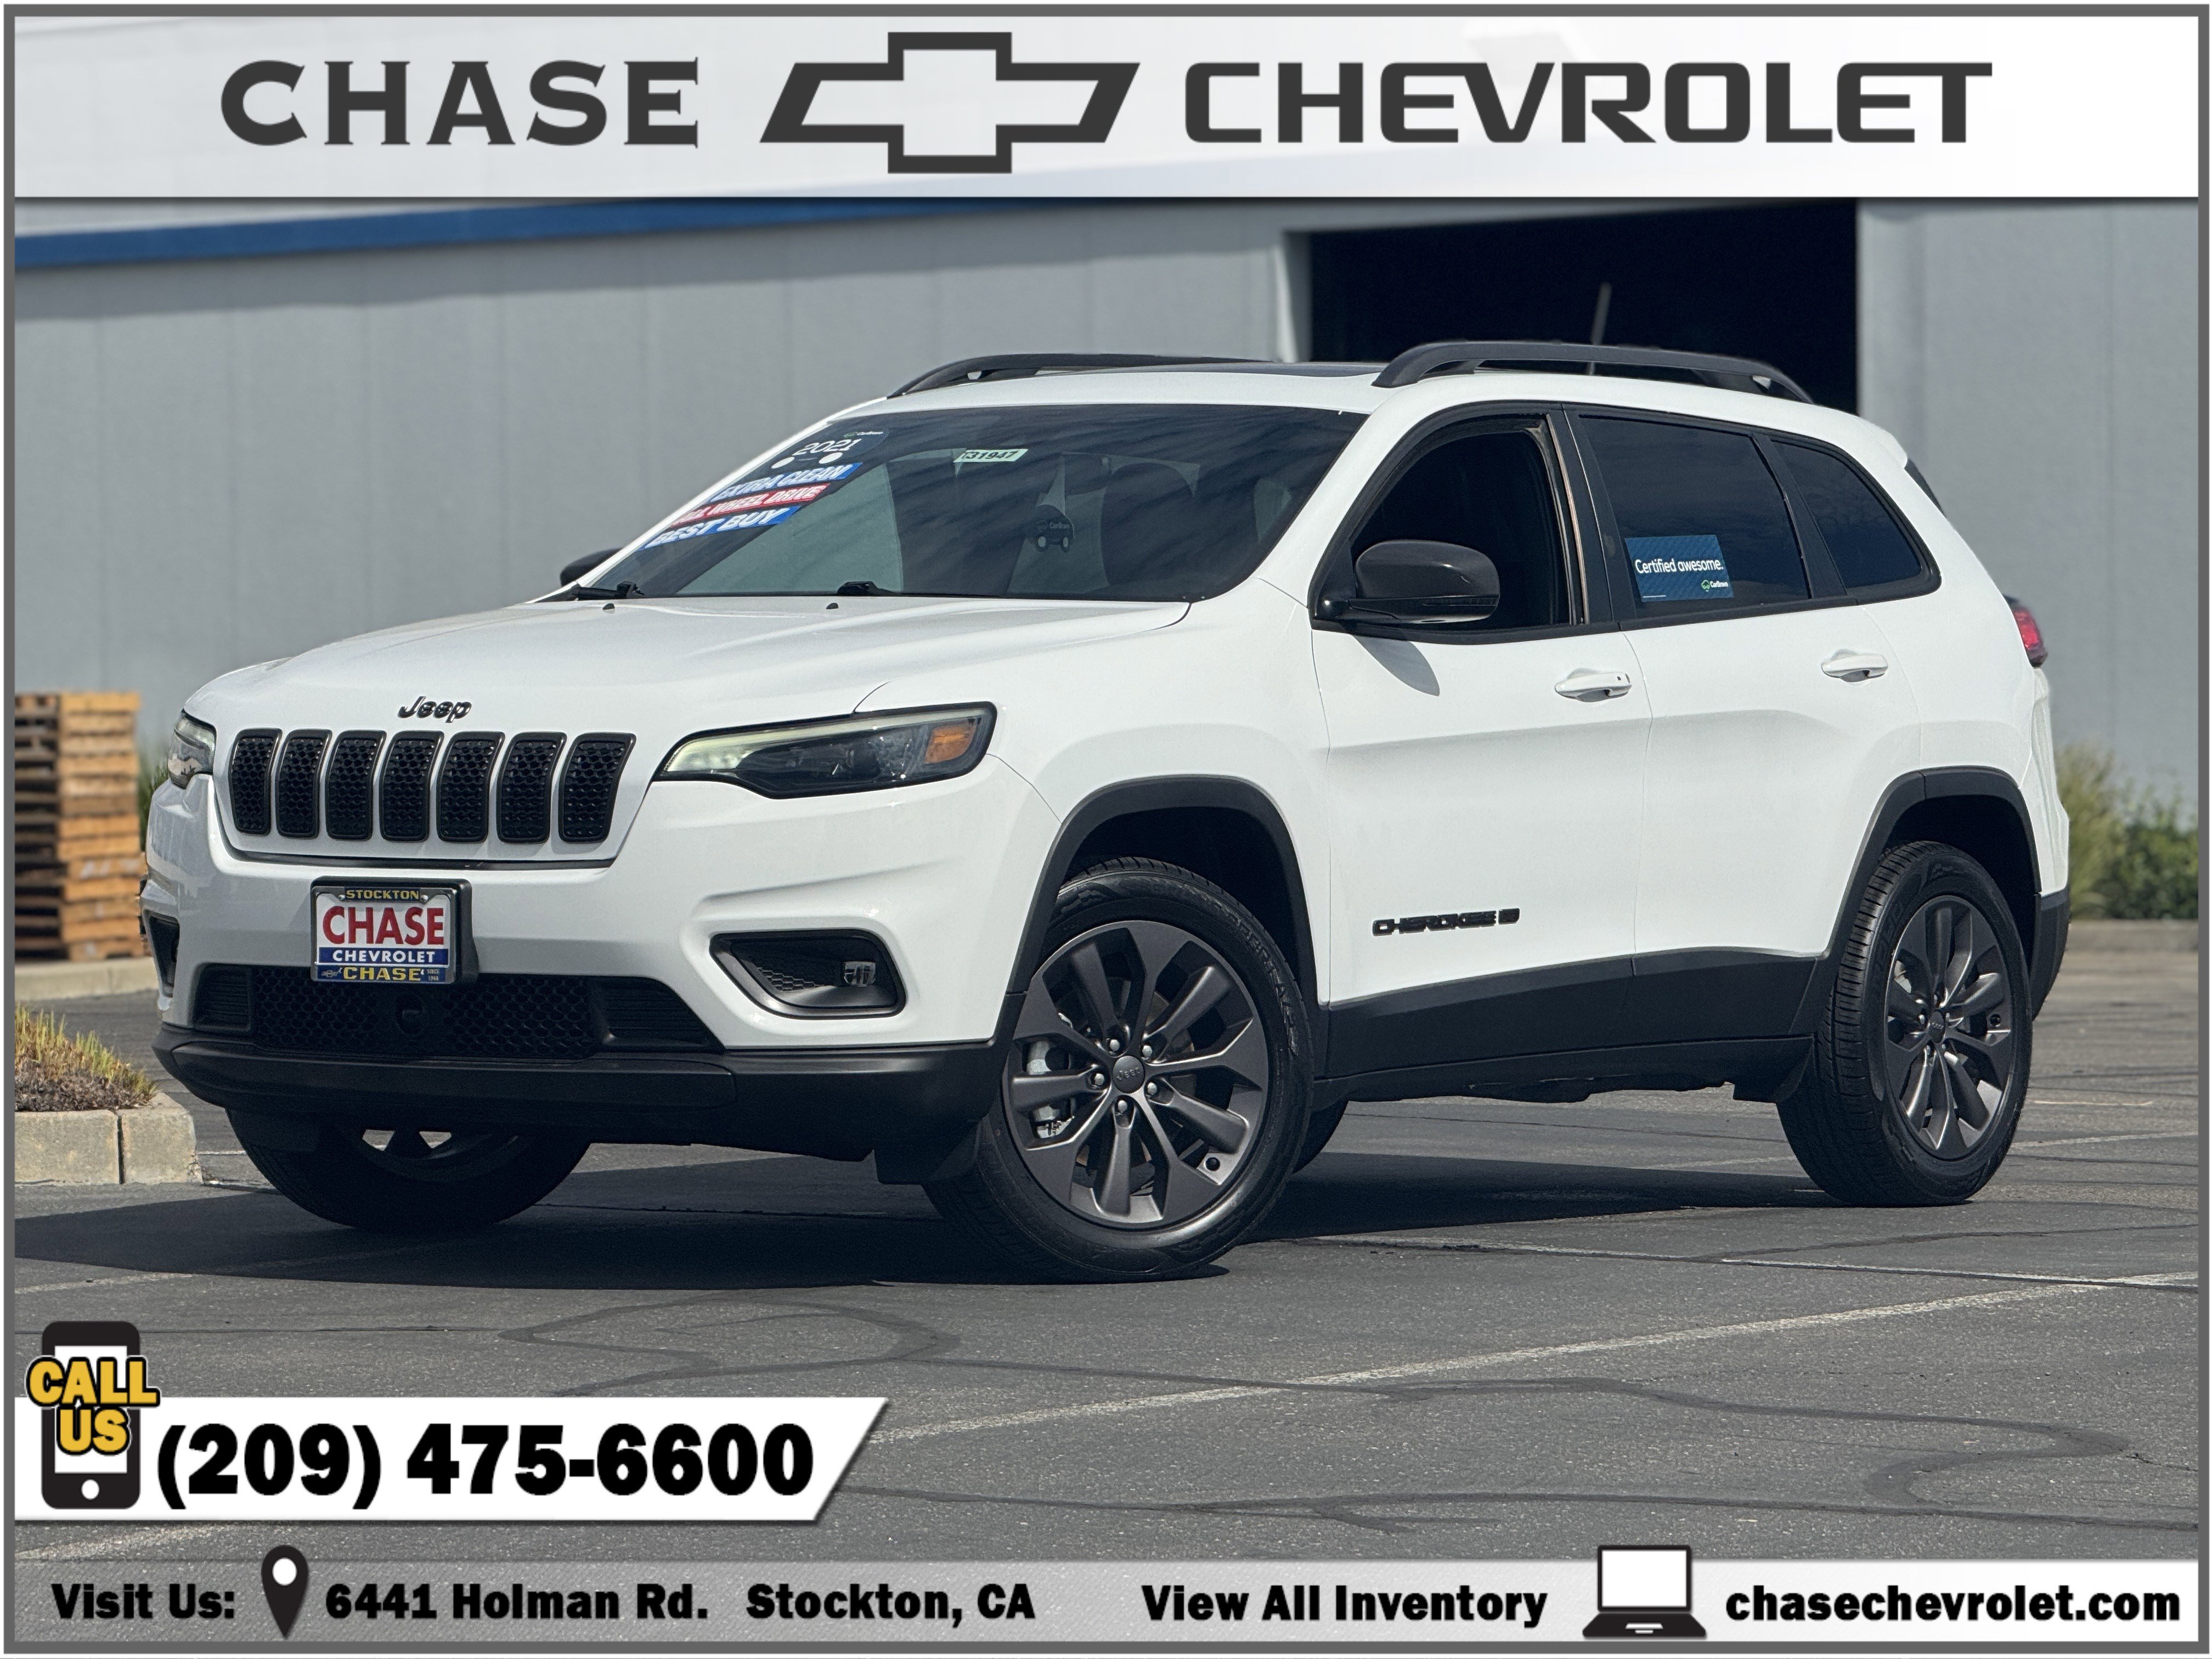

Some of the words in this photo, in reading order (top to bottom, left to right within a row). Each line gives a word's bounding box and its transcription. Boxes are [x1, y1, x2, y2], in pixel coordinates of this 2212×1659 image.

[792, 439, 862, 455] 2021
[777, 464, 853, 485] CLEAN
[764, 484, 828, 505] DRIVE
[645, 518, 726, 549] BEST
[716, 507, 791, 531] BUY
[1635, 558, 1677, 573] Certified
[1677, 559, 1724, 572] awesome.
[397, 696, 472, 723] Jeep
[346, 889, 419, 900] STOCKTON
[323, 906, 444, 945] CHASE
[332, 950, 436, 963] CHEVROLET
[343, 967, 421, 981] CHASE
